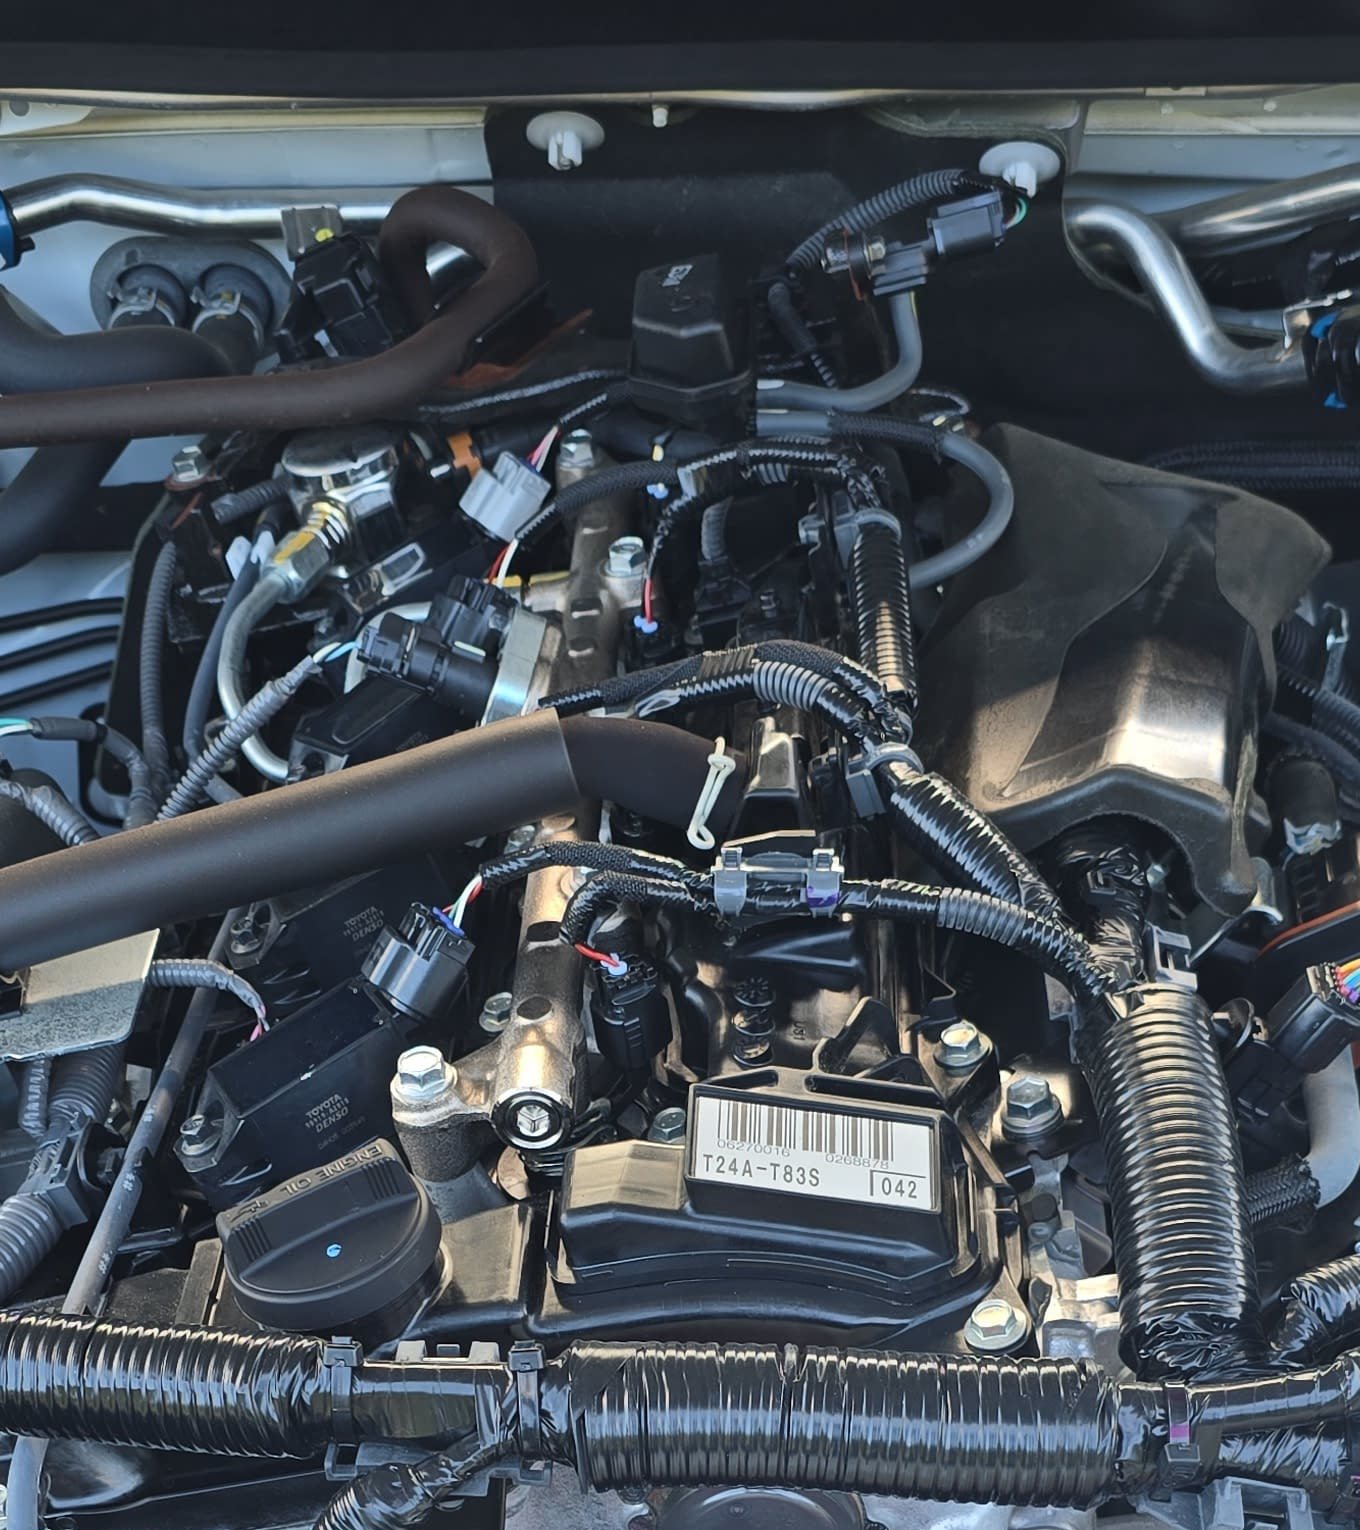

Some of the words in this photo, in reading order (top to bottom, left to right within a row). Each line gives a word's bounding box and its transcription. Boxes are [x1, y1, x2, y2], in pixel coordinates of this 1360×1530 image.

[304, 1093, 342, 1118] TOYOTA
[314, 1107, 350, 1133] DENSO
[717, 1137, 791, 1157] 06270016
[318, 1144, 382, 1180] ENGINE
[281, 1175, 312, 1197] OIL
[702, 1154, 821, 1188] T24A-T83S
[880, 1177, 918, 1200] 042
